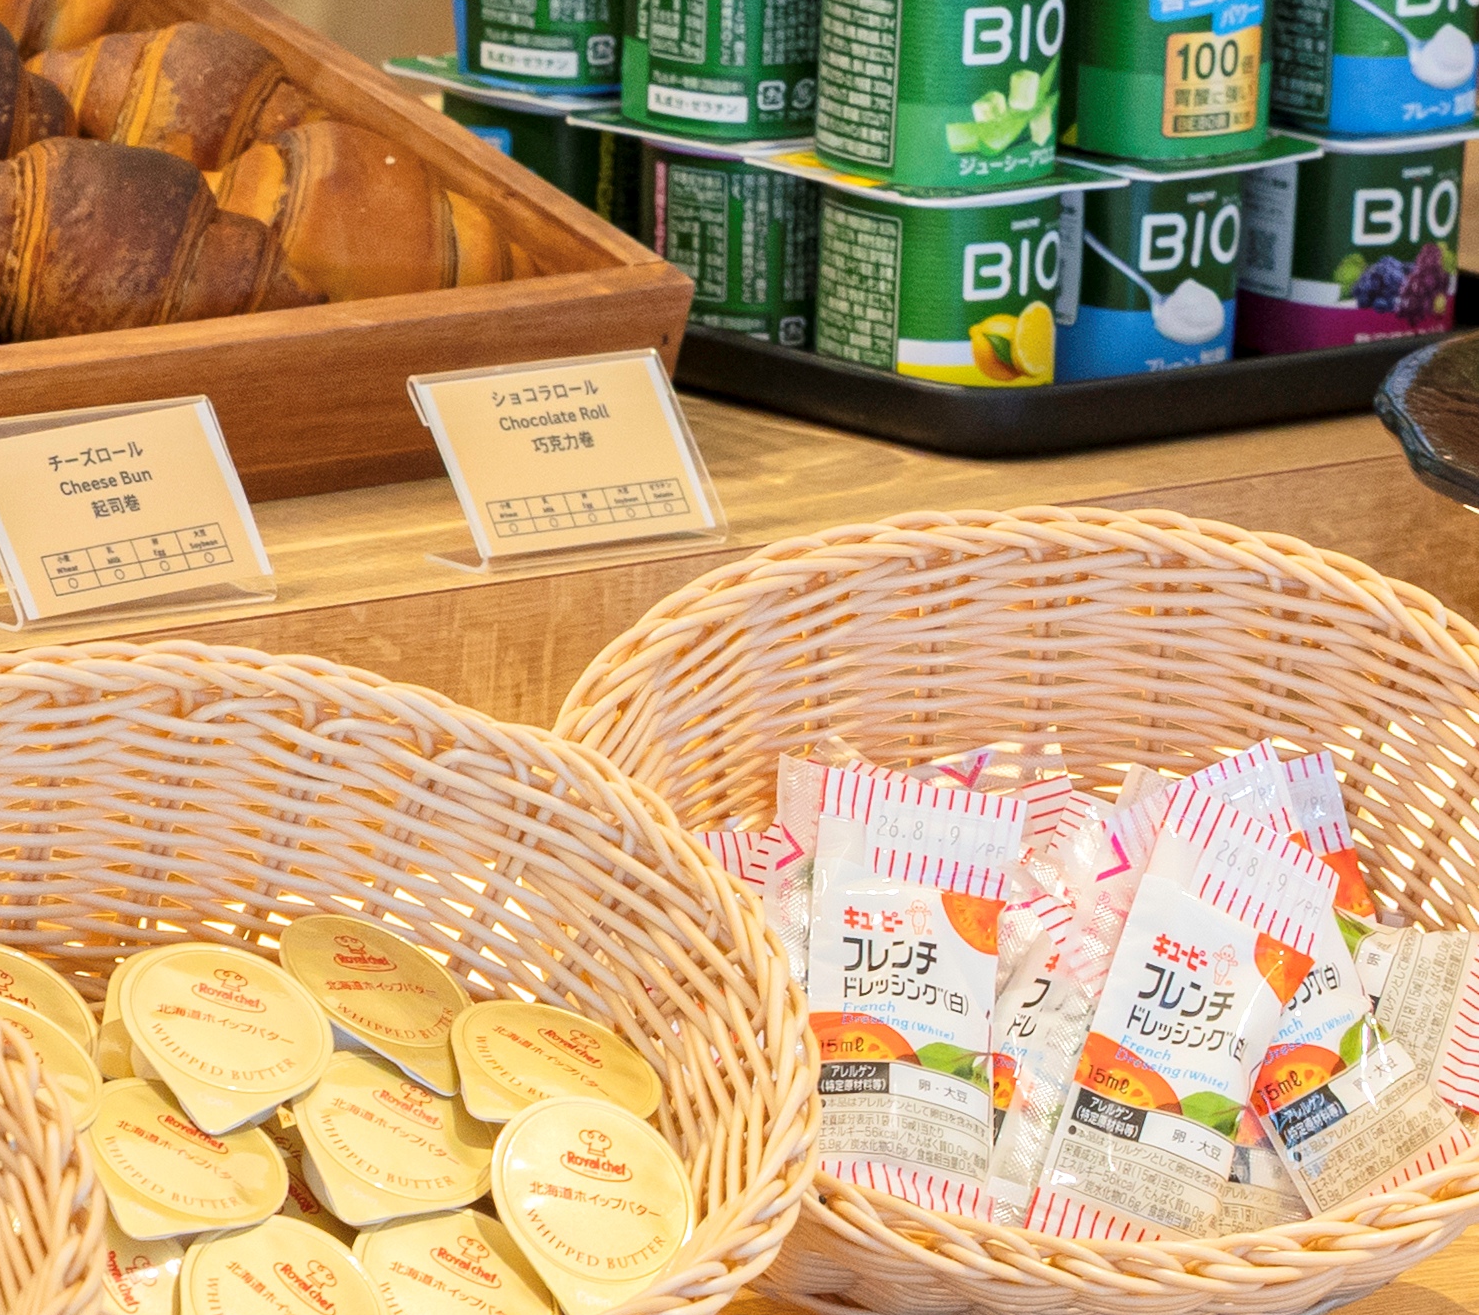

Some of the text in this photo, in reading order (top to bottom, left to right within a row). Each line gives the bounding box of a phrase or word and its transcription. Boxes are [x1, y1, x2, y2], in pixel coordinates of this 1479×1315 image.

[1177, 39, 1239, 82] 100
[1351, 180, 1458, 247] BIO
[1139, 204, 1241, 273] BIO
[491, 380, 599, 408] ショコラロール
[499, 404, 611, 432] Chocolate Roll
[48, 441, 144, 472] チーズロール
[60, 468, 153, 497] Cheese Bun
[844, 906, 903, 933] キューピー
[843, 937, 938, 975] フレンチ
[1152, 933, 1208, 972] キューピー
[842, 1001, 896, 1013] French
[1138, 962, 1235, 1021] フレンチ
[157, 1002, 295, 1046] 北海道ホイップバター
[910, 1020, 956, 1042] (White)
[151, 1022, 297, 1081] WHIPPED BUTTER
[1120, 1034, 1171, 1061] French
[831, 1065, 877, 1078] アレルゲン
[1114, 1048, 1230, 1092] Dressing (White)
[1090, 1096, 1133, 1120] アレルゲン
[320, 1114, 456, 1191] WHIPPED BUTTER
[530, 1181, 662, 1219] 北海道ホイップバター
[527, 1208, 667, 1270] WHIPPED BUTTER
